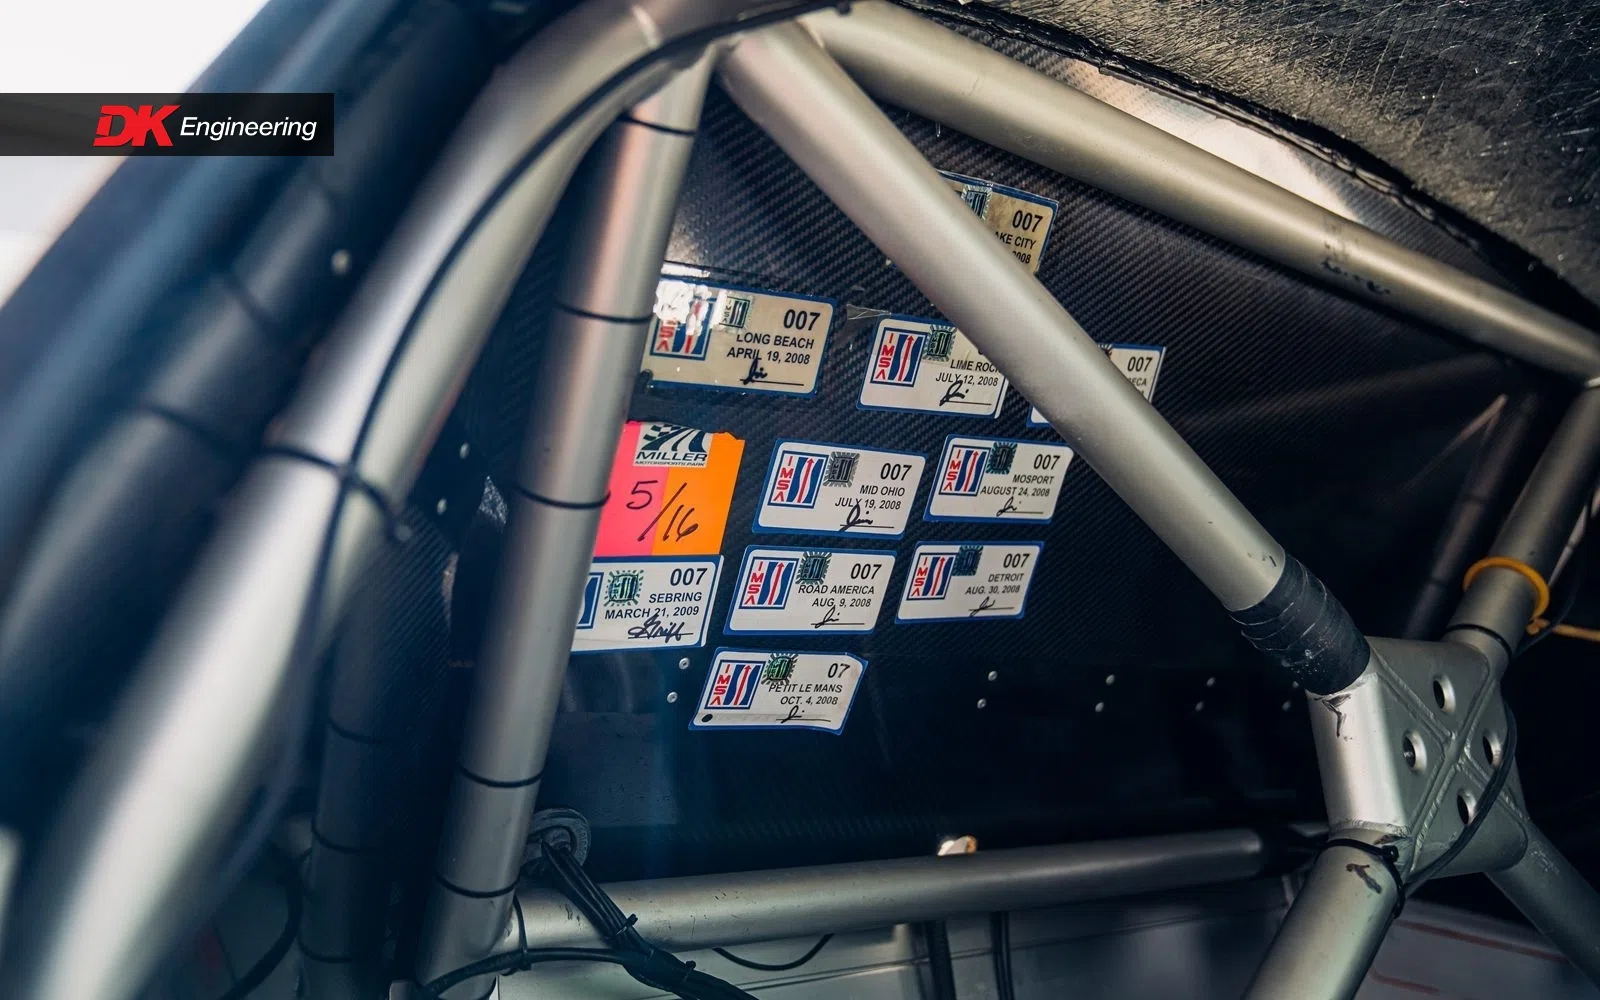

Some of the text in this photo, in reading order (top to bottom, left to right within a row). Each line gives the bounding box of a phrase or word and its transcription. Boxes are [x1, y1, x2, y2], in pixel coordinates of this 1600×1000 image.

[1012, 210, 1043, 232] 007
[994, 231, 1037, 249] KE CITY
[1012, 250, 1031, 264] 008
[783, 309, 821, 331] 007
[736, 332, 815, 349] LONG BEACH
[726, 347, 811, 365] APRIL 19, 2008
[875, 332, 896, 380] IMSA
[1127, 356, 1153, 372] 007
[950, 359, 973, 371] LIME
[935, 372, 999, 387] JULY 12, 2008
[1128, 377, 1147, 386] ECA
[636, 451, 708, 461] MILLER
[1033, 453, 1060, 470] 007
[880, 462, 912, 481] 007
[943, 449, 961, 491] IMSA
[773, 456, 794, 502] IMSA
[1012, 474, 1055, 485] MOSPORT
[859, 484, 906, 497] MID OHIO
[980, 485, 1050, 497] AUGUST 24, 2008
[835, 497, 901, 510] JULY 19, 2008
[1003, 553, 1030, 569] 007
[670, 567, 708, 586] 007
[850, 563, 882, 581] 007
[910, 556, 929, 597] IMSA
[988, 572, 1024, 583] DETROIT
[744, 561, 764, 605] IMSA
[798, 584, 875, 595] ROAD AMERICA
[965, 585, 986, 595] AUG.
[1001, 584, 1020, 594] 2008
[649, 591, 702, 604] SEBRING
[839, 598, 847, 608] 9,
[849, 598, 872, 608] 2008
[604, 605, 700, 620] MARCH 21, 2009
[827, 662, 850, 679] 07
[709, 663, 731, 706] IMSA
[768, 683, 843, 693] PETIT LE MANS
[780, 696, 839, 706] OCT. 4, 2008
